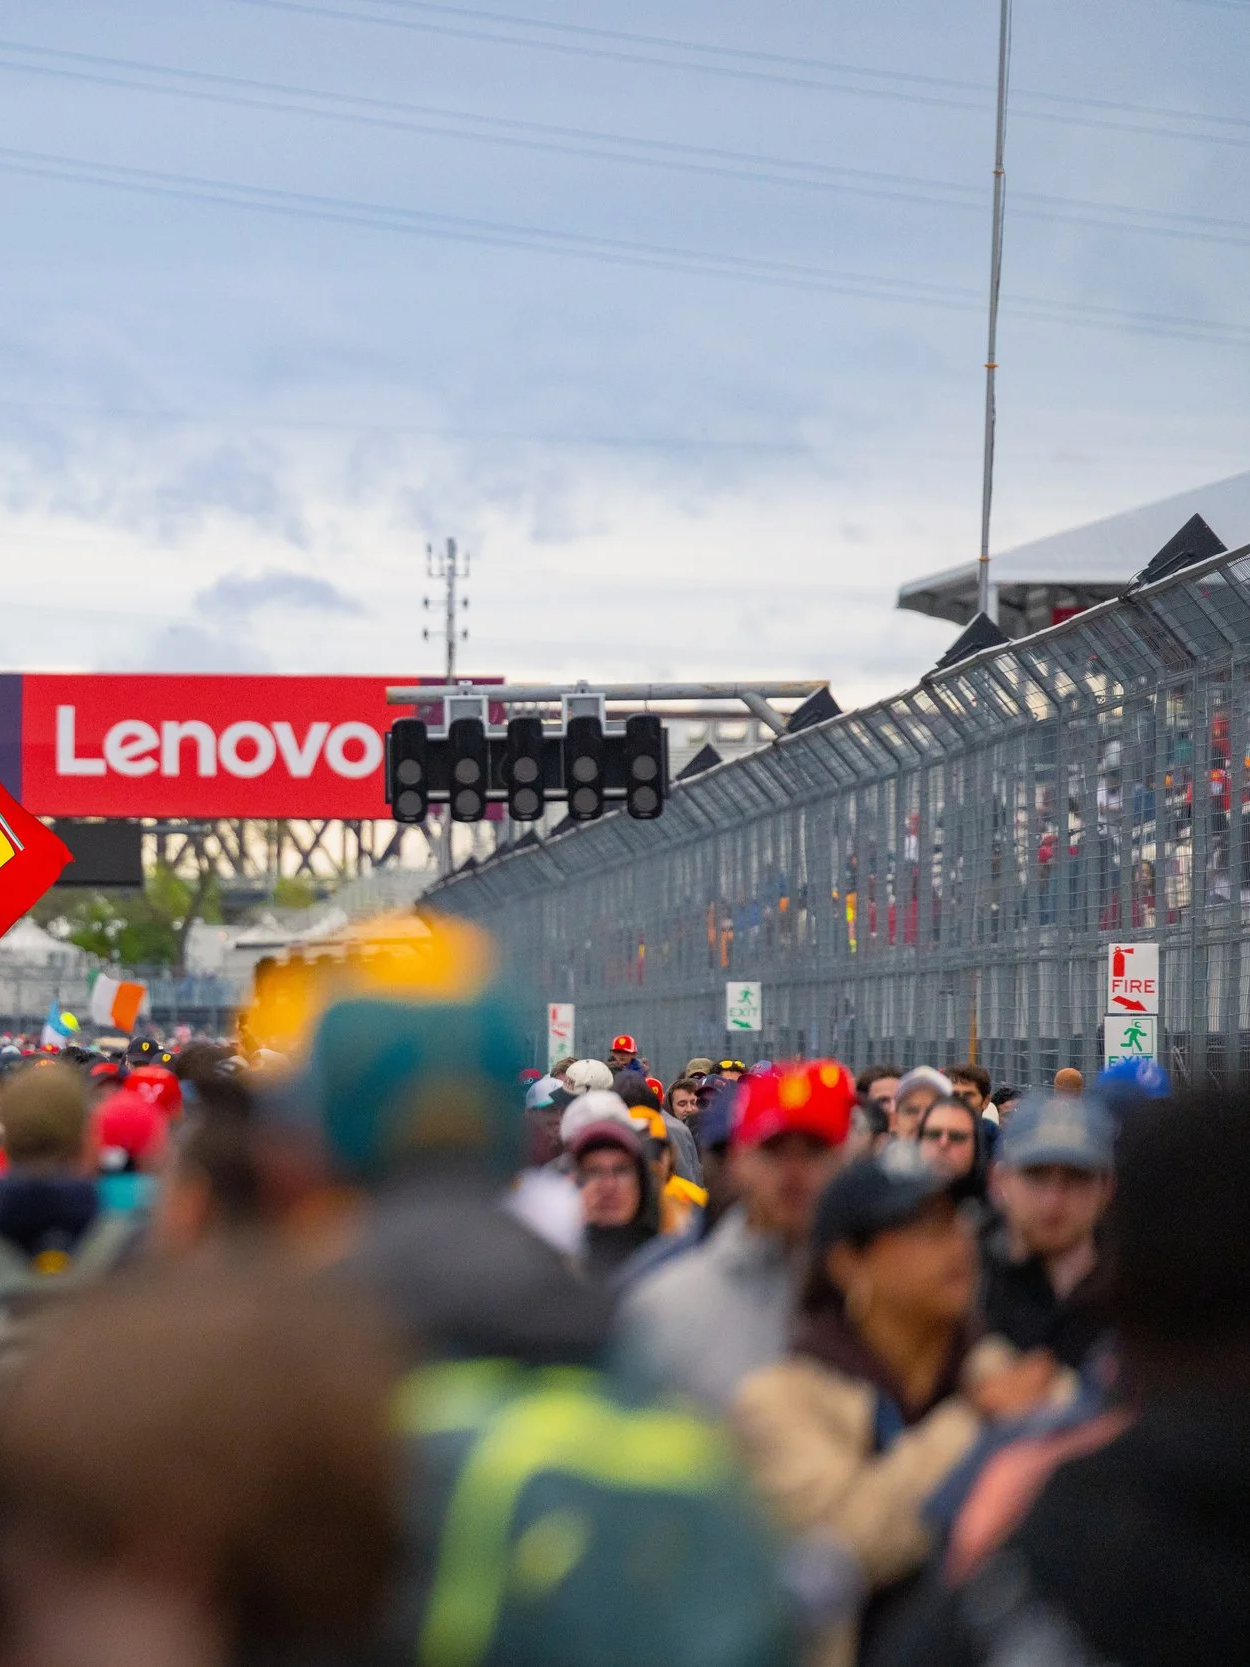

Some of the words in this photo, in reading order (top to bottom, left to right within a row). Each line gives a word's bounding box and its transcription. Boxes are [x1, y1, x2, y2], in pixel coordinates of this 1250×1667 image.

[56, 704, 384, 778] Lenovo
[1112, 980, 1155, 993] FIRE
[730, 1007, 758, 1017] EXIT
